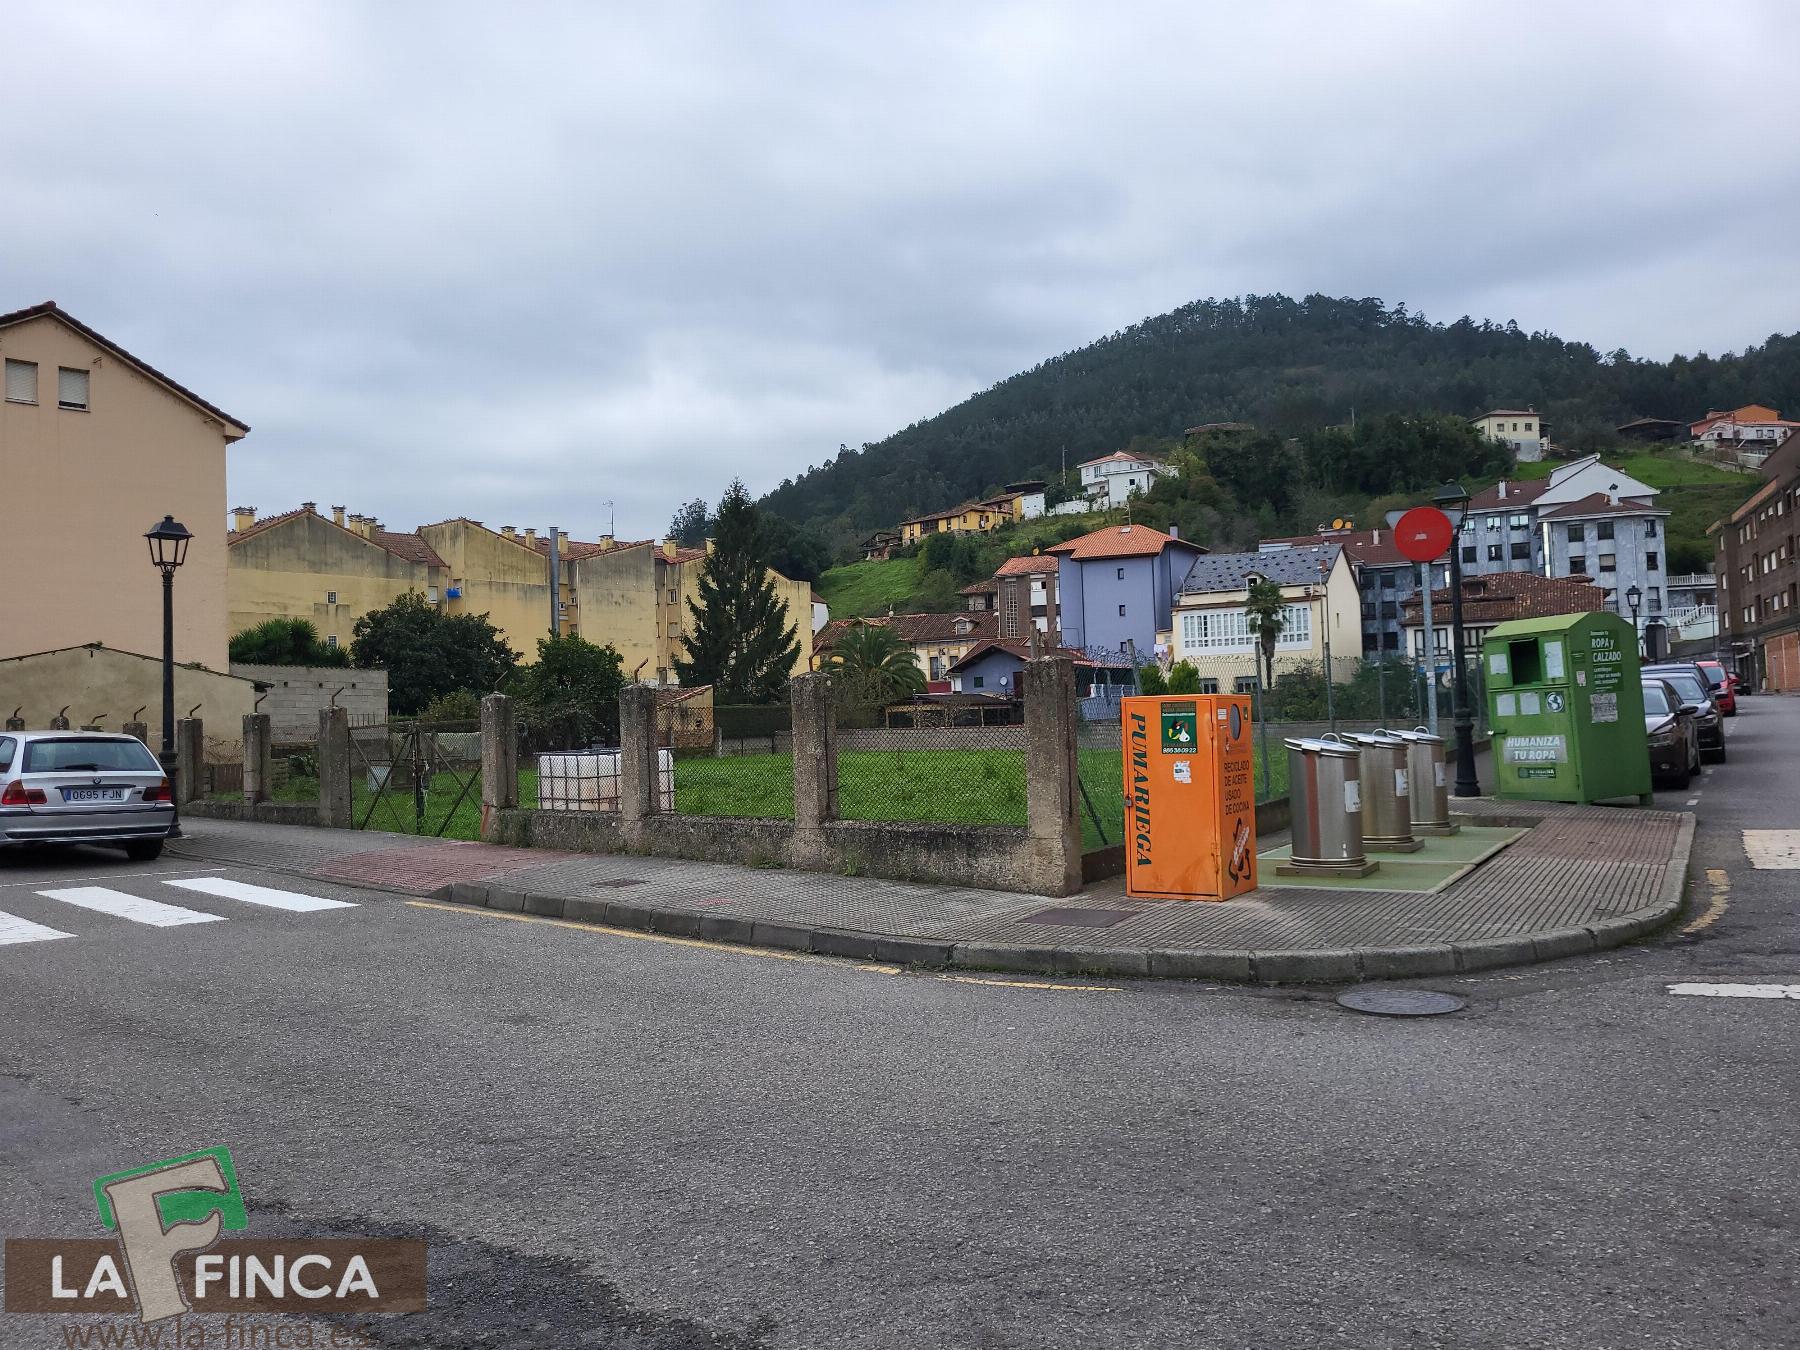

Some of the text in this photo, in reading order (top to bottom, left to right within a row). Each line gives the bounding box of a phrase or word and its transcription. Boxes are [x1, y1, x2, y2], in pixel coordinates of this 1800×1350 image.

[1591, 638, 1609, 648] ROPA
[1593, 651, 1621, 662] CALZADO
[1507, 736, 1560, 748] HUMANIZA
[1514, 749, 1556, 760] TU ROPA
[1224, 760, 1249, 773] RECICLADO
[1224, 773, 1247, 787] DE ACEITE
[73, 790, 122, 800] 0695 FJN
[1131, 711, 1152, 867] PUMARIEGA
[1225, 788, 1241, 801] USADO
[1225, 801, 1249, 815] DE COCINA
